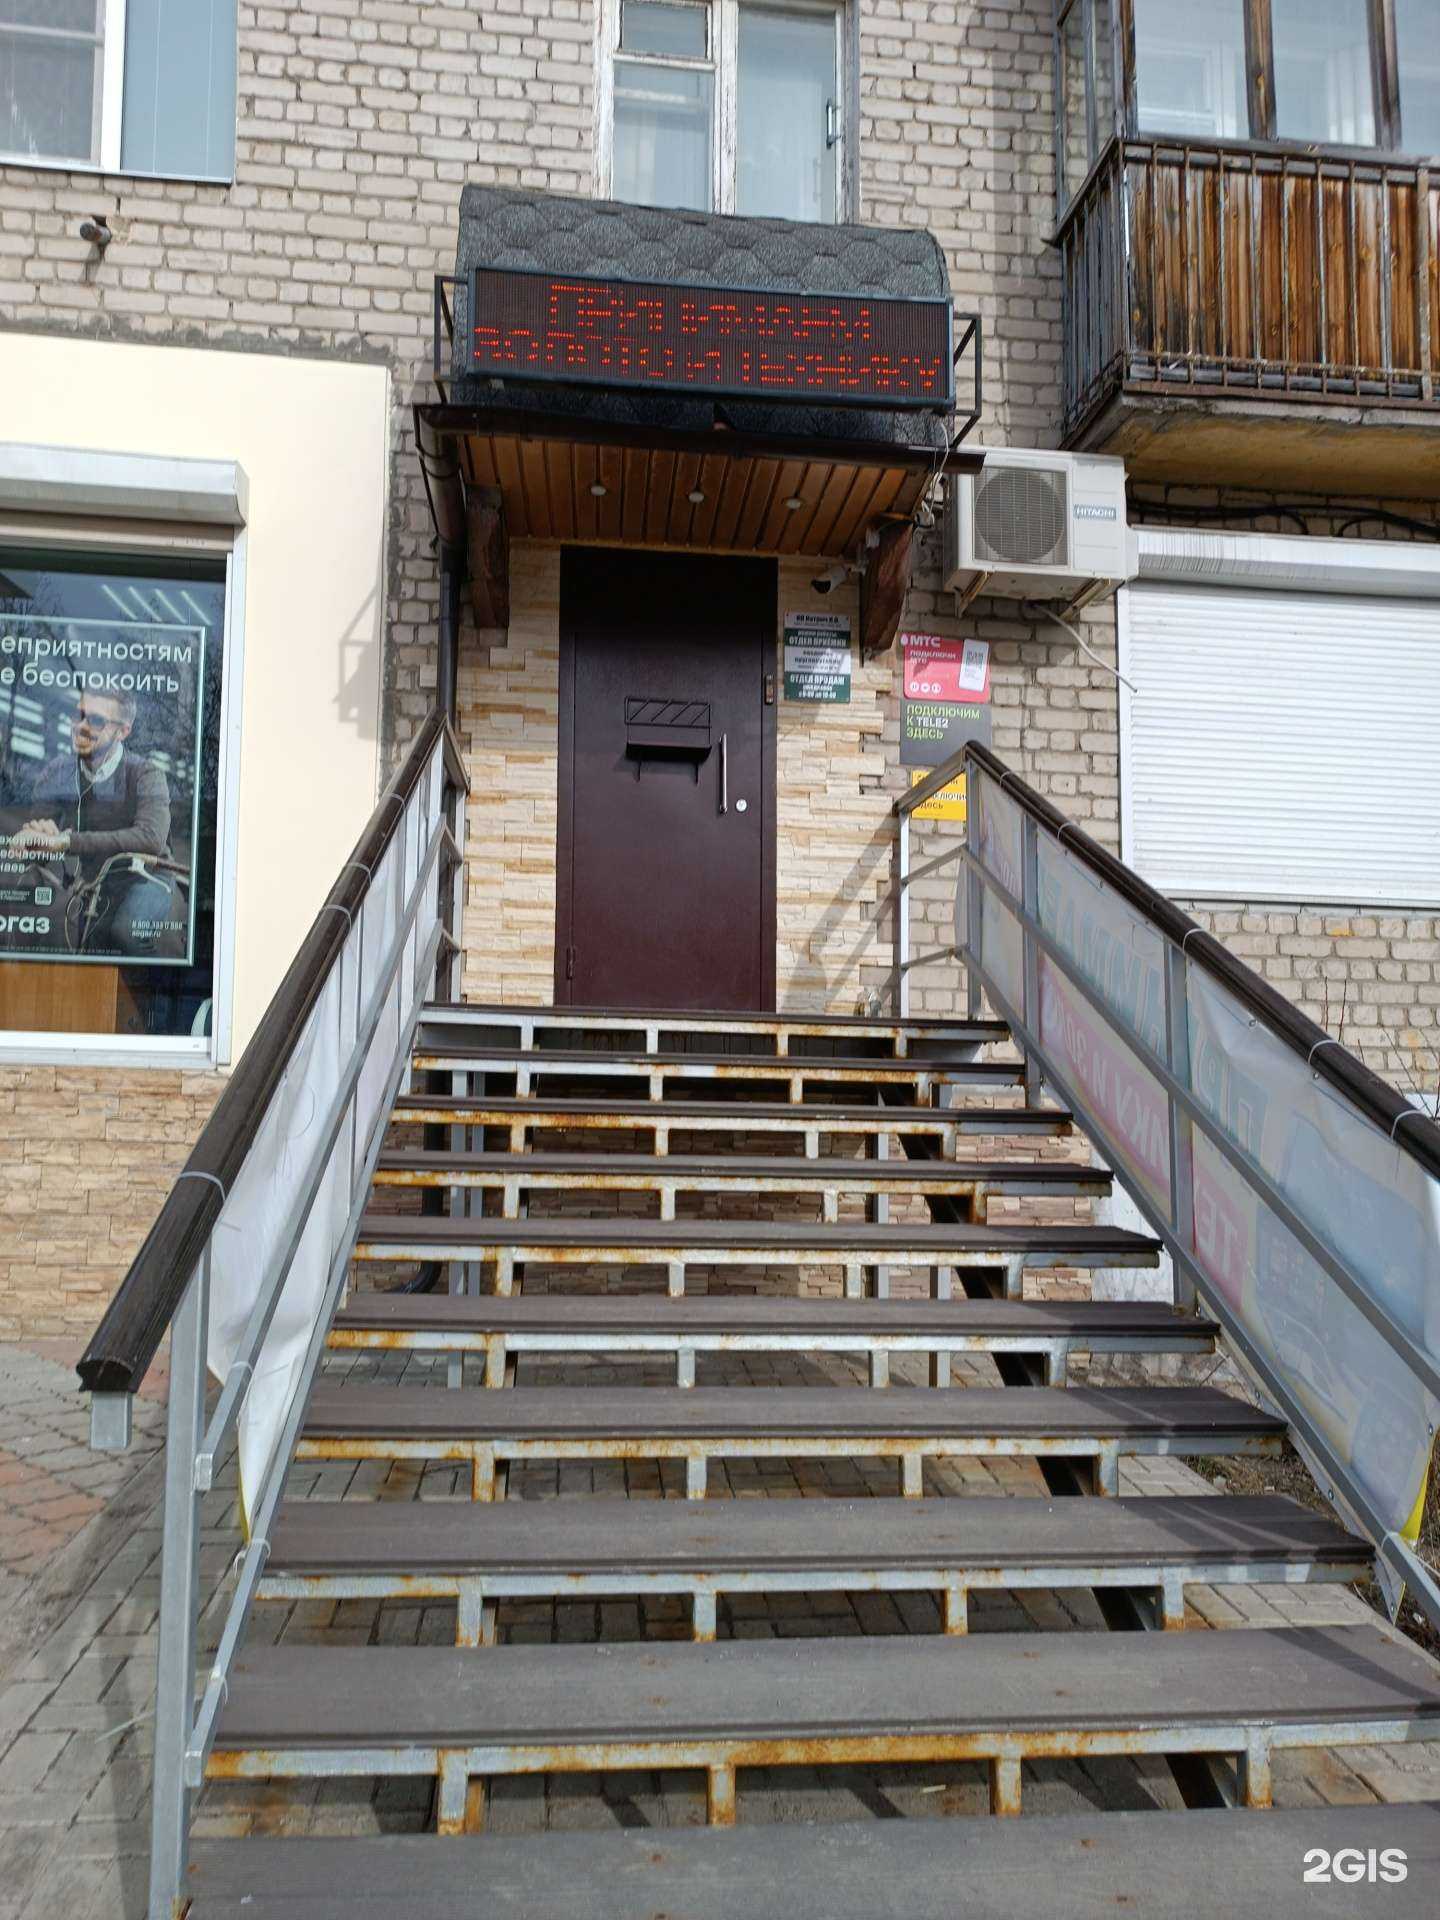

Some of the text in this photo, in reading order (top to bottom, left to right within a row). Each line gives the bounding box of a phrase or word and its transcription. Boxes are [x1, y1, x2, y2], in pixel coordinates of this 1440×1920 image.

[1076, 506, 1115, 519] HITACHI
[0, 635, 192, 663] еприятностям
[910, 635, 941, 648] МТС
[0, 662, 179, 693] е беспокоить
[906, 704, 981, 720] ПОДКЛЮЧИМ
[906, 716, 949, 729] К TELE2
[906, 726, 944, 740] ЗДЕСЬ
[0, 915, 50, 934] огаз
